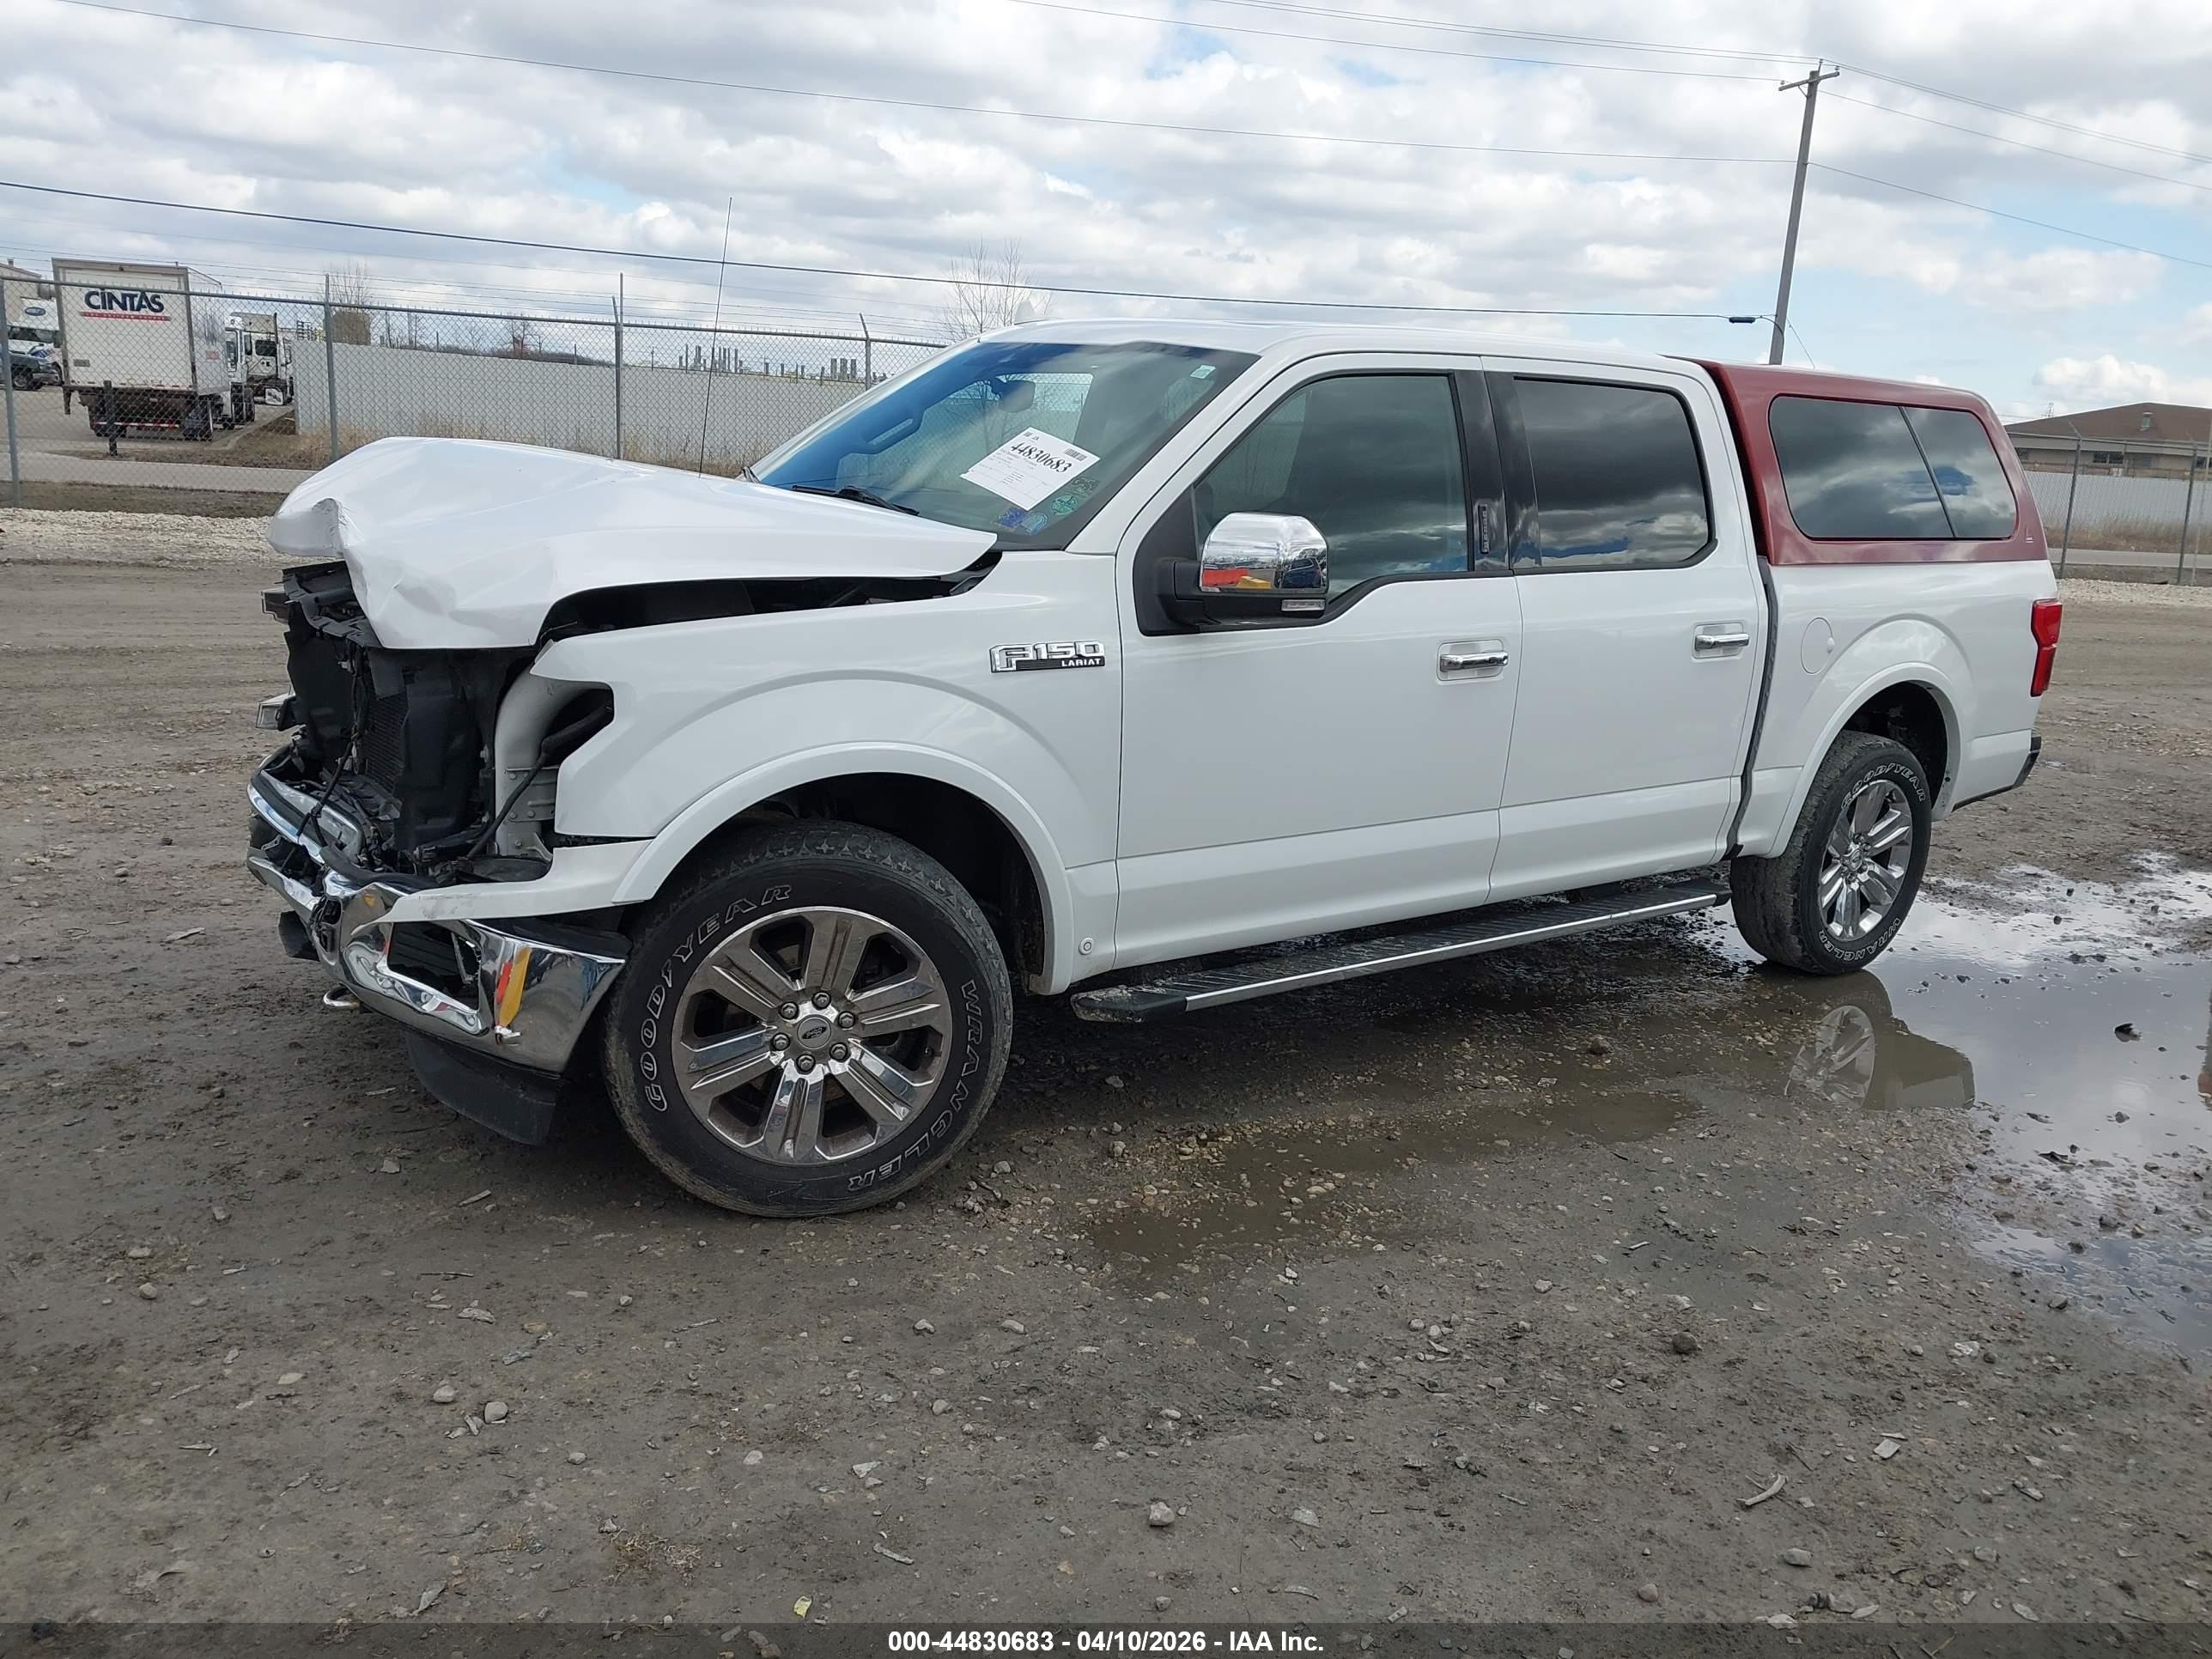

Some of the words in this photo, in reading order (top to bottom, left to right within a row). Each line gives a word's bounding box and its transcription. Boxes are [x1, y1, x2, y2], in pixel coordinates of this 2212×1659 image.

[84, 289, 165, 313] CINTAS
[1011, 441, 1073, 473] 44830683
[1061, 658, 1102, 667] LARIAT
[1818, 918, 1902, 962] WRANGLER
[641, 884, 792, 1113] GOODYEAR
[848, 979, 984, 1192] WRANGLER
